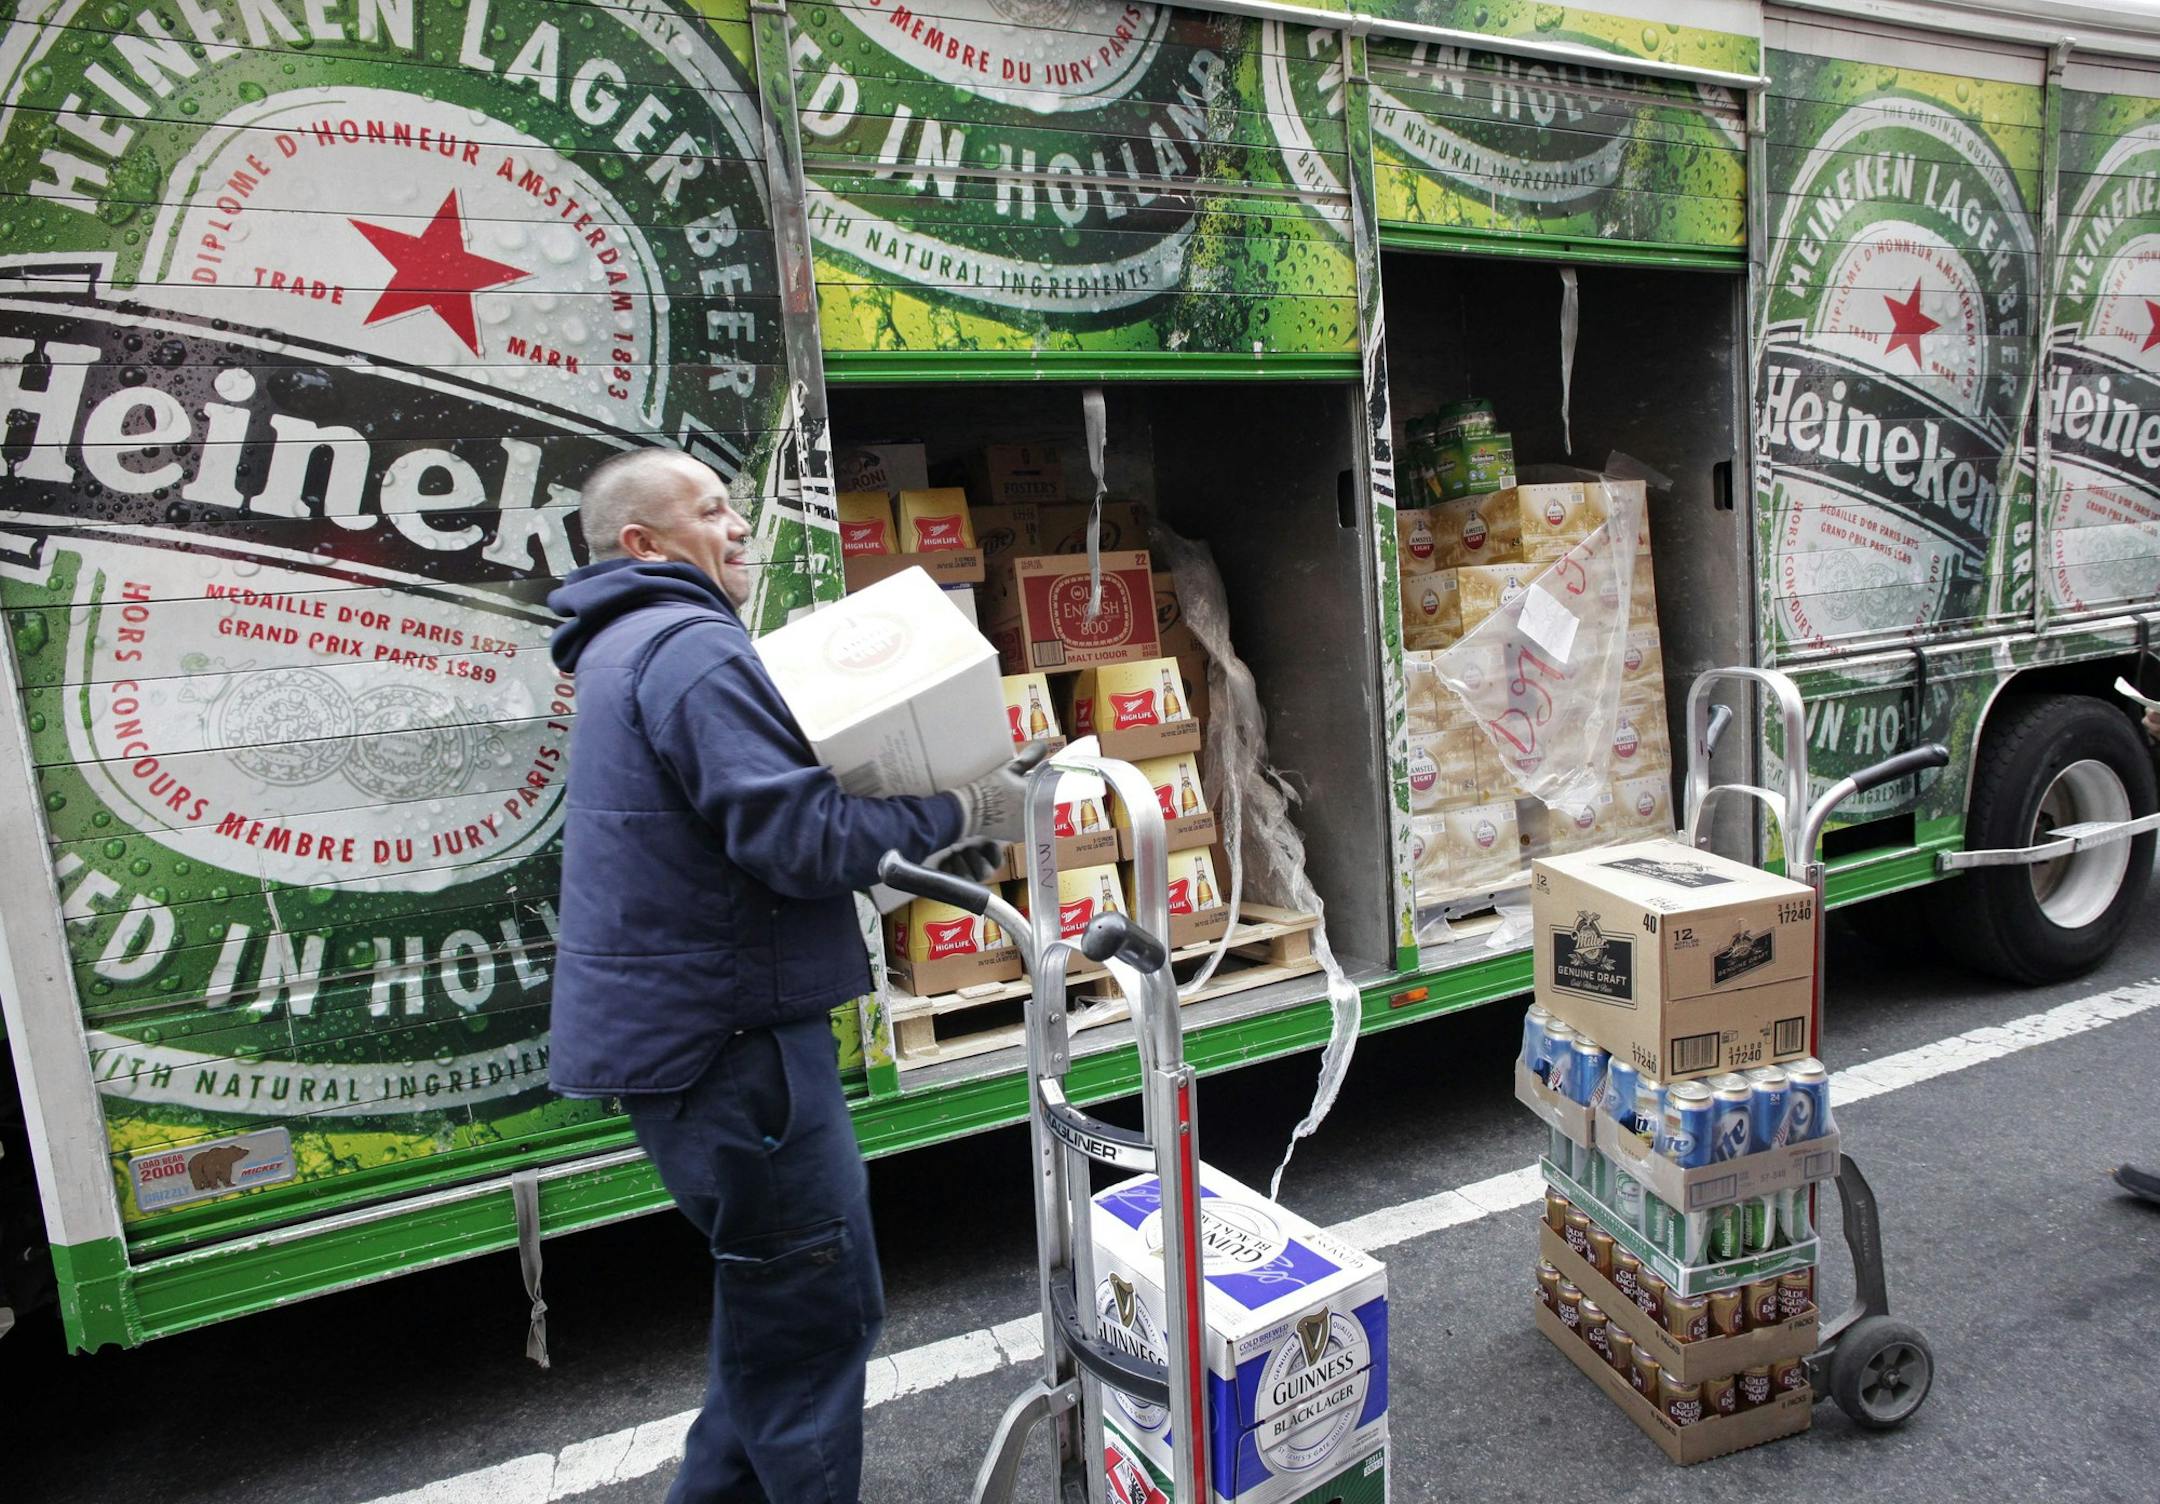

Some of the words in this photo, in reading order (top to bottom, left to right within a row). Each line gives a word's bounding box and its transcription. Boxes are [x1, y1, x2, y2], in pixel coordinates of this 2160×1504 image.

[887, 10, 989, 73] MEMBRE
[1002, 57, 1031, 84] DU
[1044, 53, 1097, 86] JURY
[1099, 4, 1141, 67] PARIS
[873, 104, 966, 207] IN
[1403, 119, 1482, 177] NATURAL
[1488, 164, 1596, 193] INGREDIENTS
[1881, 104, 1904, 120] THE
[1908, 105, 1964, 146] ORIGINAL
[1966, 140, 2007, 189] QUALITY
[30, 0, 414, 213] HEINEKEN
[459, 0, 702, 202] LAGER
[686, 205, 758, 400] BEER
[192, 153, 271, 285] DIPLOME
[275, 118, 482, 167] D'HONNEUR
[496, 156, 635, 313] AMSTERDAM
[607, 331, 636, 400] 1883
[865, 228, 985, 289] NATURAL
[999, 259, 1151, 300] INGREDIENTS
[1784, 151, 1916, 299] HEINEKEN
[1923, 163, 2013, 283] LAGER
[1997, 283, 2020, 396] BEER
[253, 267, 345, 306] TRADE
[1829, 259, 1863, 334] DIPLOME
[1864, 239, 1933, 263] D'HONNEUR
[1935, 257, 1977, 347] AMSTERDAM
[1848, 323, 1880, 345] TRADE
[508, 336, 582, 376] MARK
[1931, 360, 1957, 385] MARK
[1767, 365, 2000, 541] Heineken
[1465, 526, 1485, 535] AMSTEL
[1787, 500, 1804, 547] HORS
[1819, 503, 1858, 525] MEDAILLE
[1880, 524, 1901, 542] PARIS
[845, 542, 864, 550] HIGH
[865, 541, 880, 549] LIFE
[924, 537, 942, 545] HIGH
[943, 536, 958, 545] LIFE
[1411, 536, 1433, 544] AMSTEL
[1467, 534, 1483, 543] LIGHT
[1820, 521, 1847, 539] GRAND
[1870, 540, 1893, 556] PARIS
[1135, 554, 1147, 566] 22
[1784, 555, 1813, 639] CONCOURS
[115, 580, 152, 663] HORS
[205, 582, 327, 620] MEDAILLE
[337, 608, 391, 632] D'OR
[400, 615, 464, 648] PARIS
[470, 631, 520, 659] 1875
[217, 616, 300, 646] GRAND
[308, 630, 364, 659] PRIX
[373, 643, 442, 672] PARIS
[446, 657, 499, 684] 1889
[1068, 653, 1094, 663] MALT
[1095, 650, 1128, 661] LIQUOR
[1120, 713, 1138, 722] HIGH
[1138, 711, 1153, 720] LIFE
[110, 679, 209, 823] CONCOURS
[1616, 735, 1636, 743] AMSTEL
[1618, 742, 1635, 751] LIGHT
[504, 745, 561, 822] PARIS
[1411, 765, 1434, 774] AMSTEL
[1413, 774, 1432, 783] LIGHT
[215, 811, 355, 863] MEMBRE
[431, 812, 503, 859] JURY
[374, 839, 413, 864] DU
[1536, 873, 1547, 887] 12
[1643, 912, 1658, 934] 40
[1777, 907, 1812, 925] 17240
[935, 942, 954, 952] HIGH
[955, 940, 970, 949] LIFE
[940, 926, 961, 942] Miller
[1571, 930, 1607, 949] Miller
[1673, 928, 1693, 942] 12
[202, 922, 326, 1017] IN
[1557, 965, 1595, 981] GENUINE
[1597, 972, 1627, 986] DRAFT
[1632, 1049, 1657, 1074] 17240
[1728, 1049, 1762, 1066] 17240
[194, 1070, 361, 1104] NATURAL
[1769, 1094, 1780, 1102] 24
[138, 1158, 160, 1170] LOAD
[162, 1153, 185, 1165] BEAR
[140, 1162, 186, 1183] 2000
[241, 1162, 284, 1177] MICKEY
[1239, 1337, 1259, 1352] COLD
[1259, 1323, 1289, 1343] BREWED
[1273, 1342, 1296, 1381] GENUINE
[1332, 1321, 1355, 1343] QUALITY
[1273, 1350, 1354, 1406] GUINNESS
[1274, 1405, 1315, 1437] BLACK
[1316, 1384, 1354, 1413] LAGER
[1312, 1442, 1331, 1457] GATE
[1331, 1411, 1351, 1440] DUBLIN
